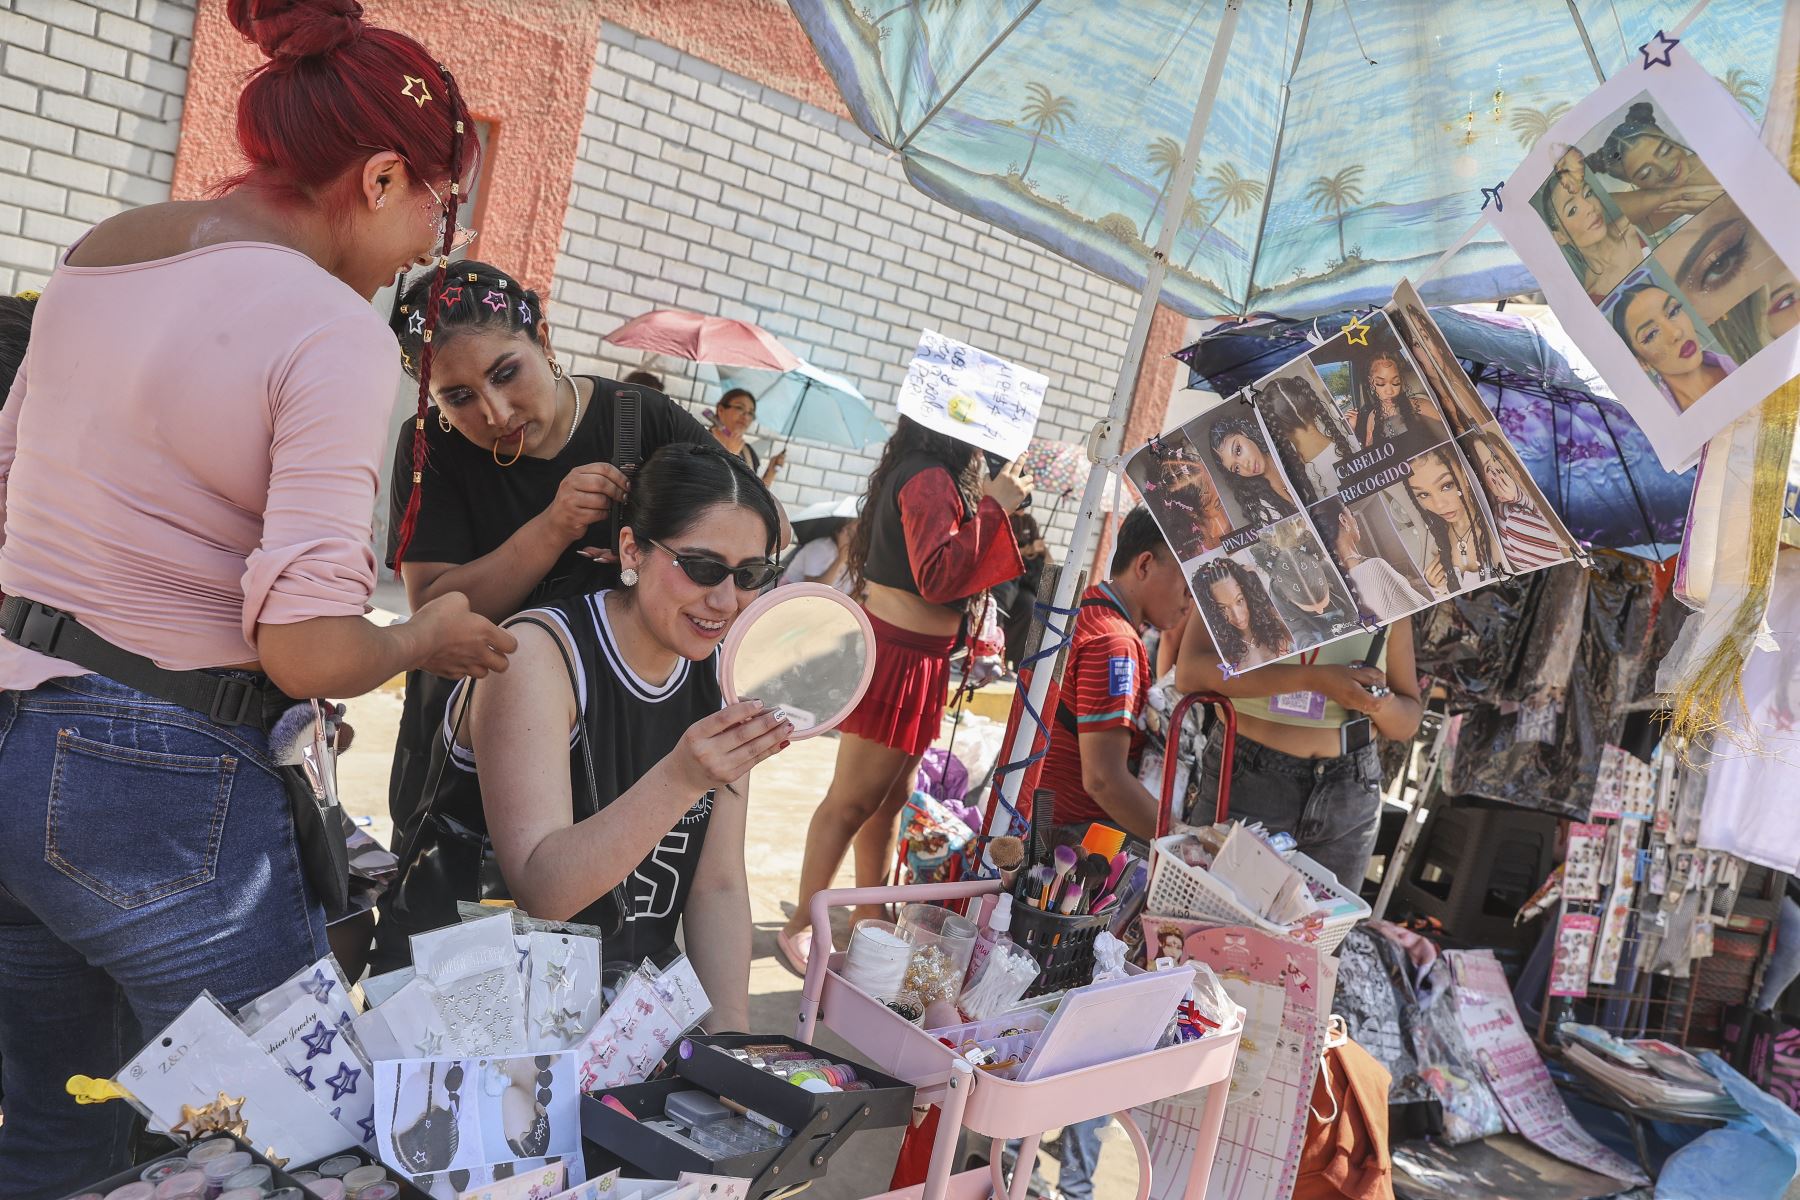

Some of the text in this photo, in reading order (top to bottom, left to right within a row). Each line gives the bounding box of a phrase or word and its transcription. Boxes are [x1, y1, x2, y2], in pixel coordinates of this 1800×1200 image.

[910, 363, 929, 396] PER
[1336, 442, 1395, 479] CABELLO
[1340, 461, 1411, 503] RECOGIDO
[1222, 527, 1261, 552] PINZAS
[289, 1012, 317, 1041] Jewelry
[158, 1045, 189, 1074] Z&D
